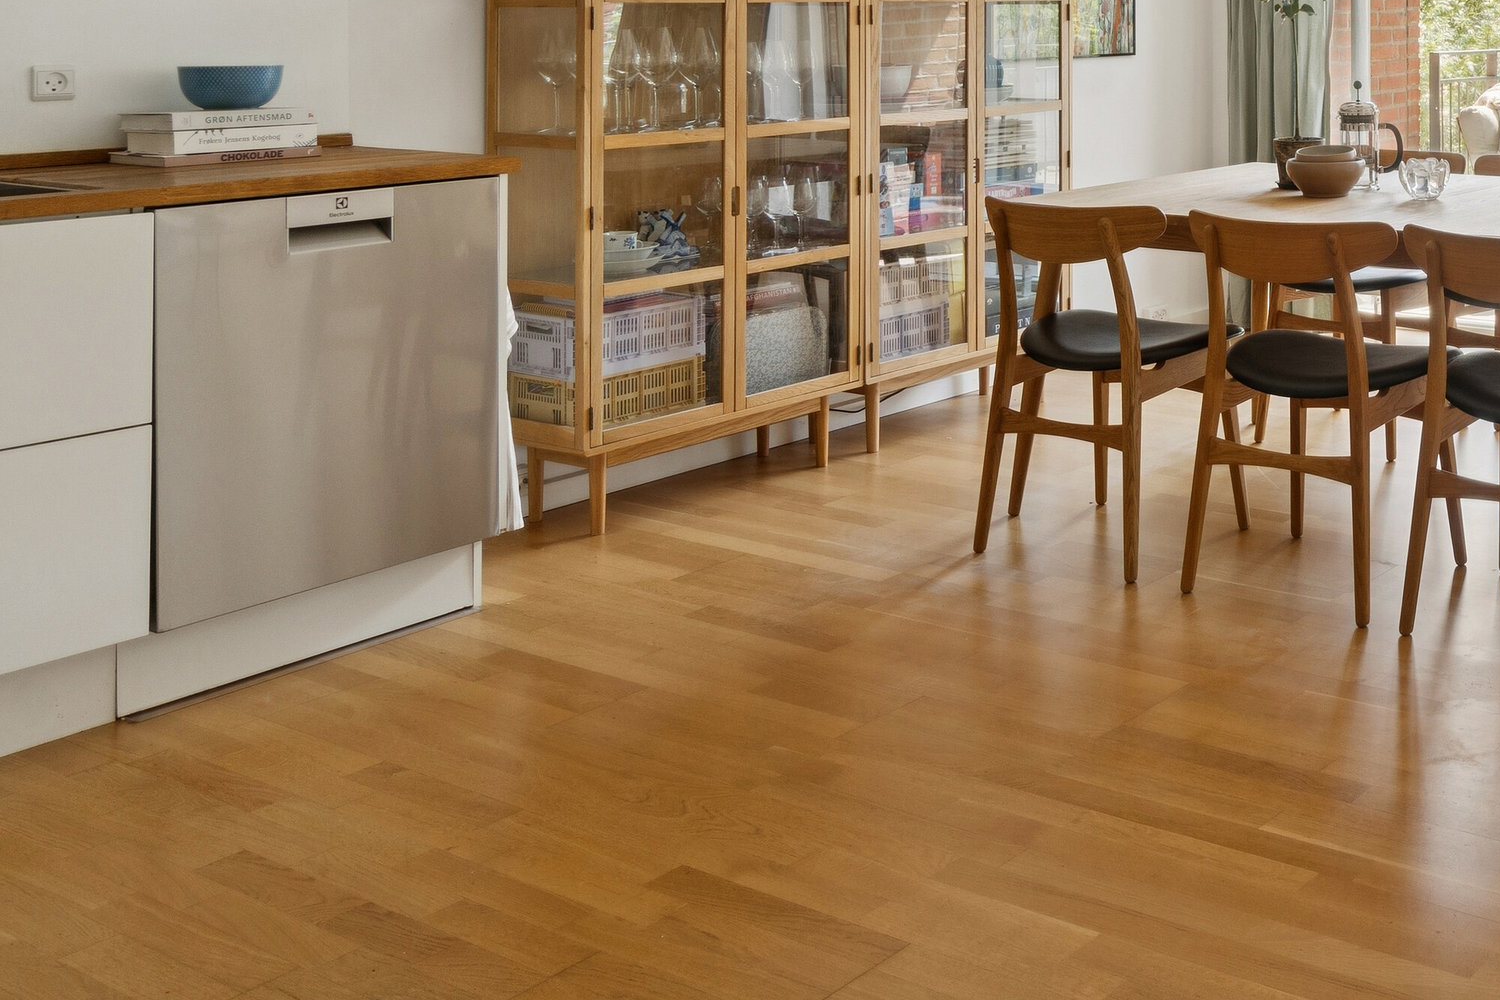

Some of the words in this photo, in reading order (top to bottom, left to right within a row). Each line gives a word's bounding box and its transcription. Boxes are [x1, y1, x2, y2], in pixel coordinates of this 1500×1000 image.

[205, 115, 233, 124] GRØN
[236, 112, 293, 122] AFTENSMAD
[198, 137, 222, 145] Frøken
[224, 135, 250, 144] Jensens
[252, 133, 280, 143] Kogebog
[220, 150, 284, 162] CHOKOLADE
[746, 287, 792, 301] AFGHANISTAN
